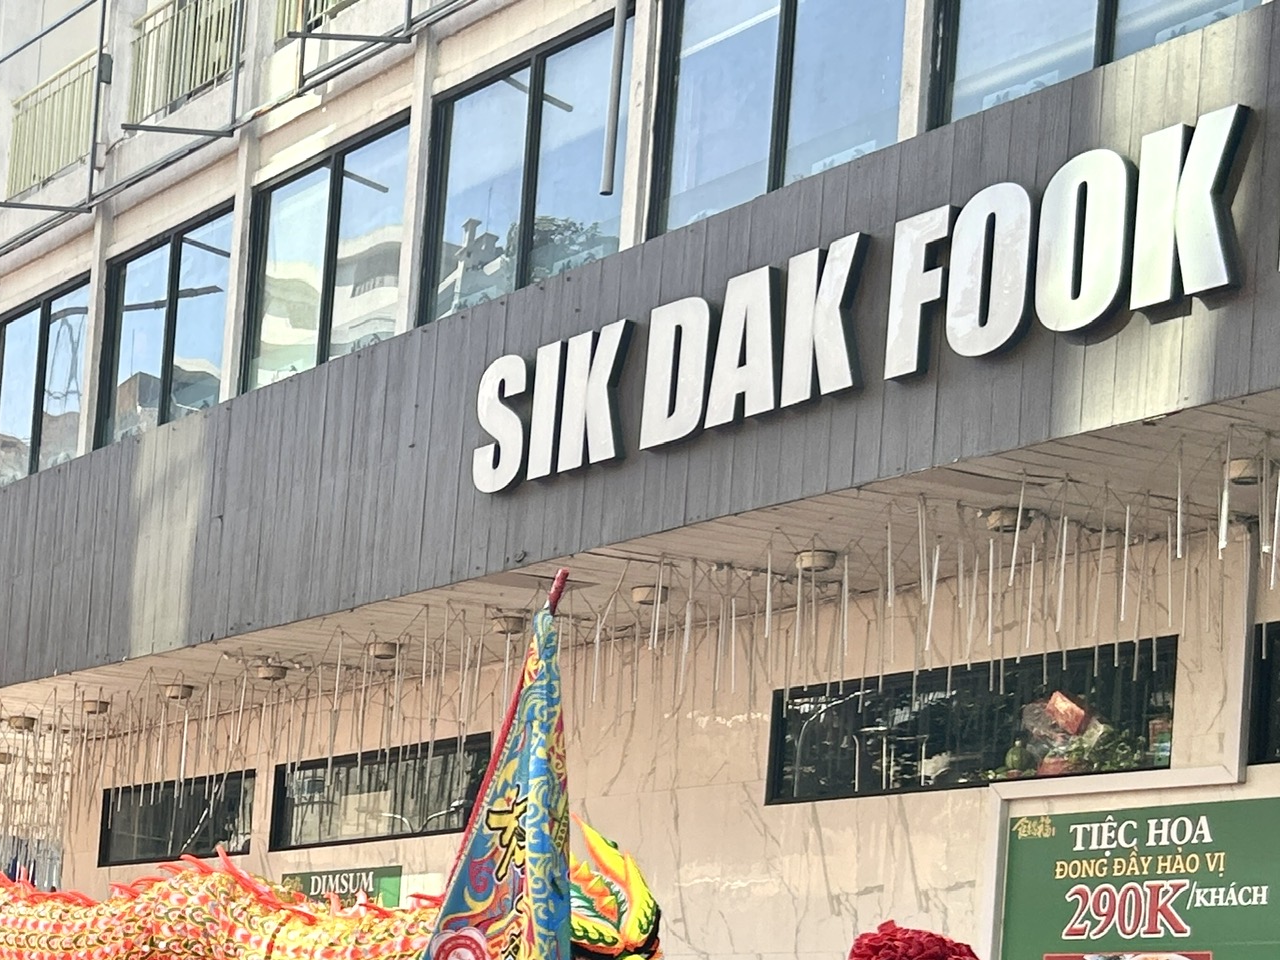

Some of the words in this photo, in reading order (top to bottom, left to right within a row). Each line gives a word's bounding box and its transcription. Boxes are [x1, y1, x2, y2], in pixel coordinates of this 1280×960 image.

[472, 318, 635, 494] SIK
[639, 231, 870, 450] DAK
[884, 104, 1248, 380] FOOK
[1069, 815, 1138, 856] TIỆC
[1146, 815, 1213, 849] HOA
[309, 871, 375, 896] DIMSUM
[1054, 858, 1108, 880] ĐONG
[1112, 846, 1151, 878] ĐẦY
[1156, 847, 1199, 875] HẢO
[1206, 851, 1225, 878] VỊ
[1061, 879, 1190, 940] 290K
